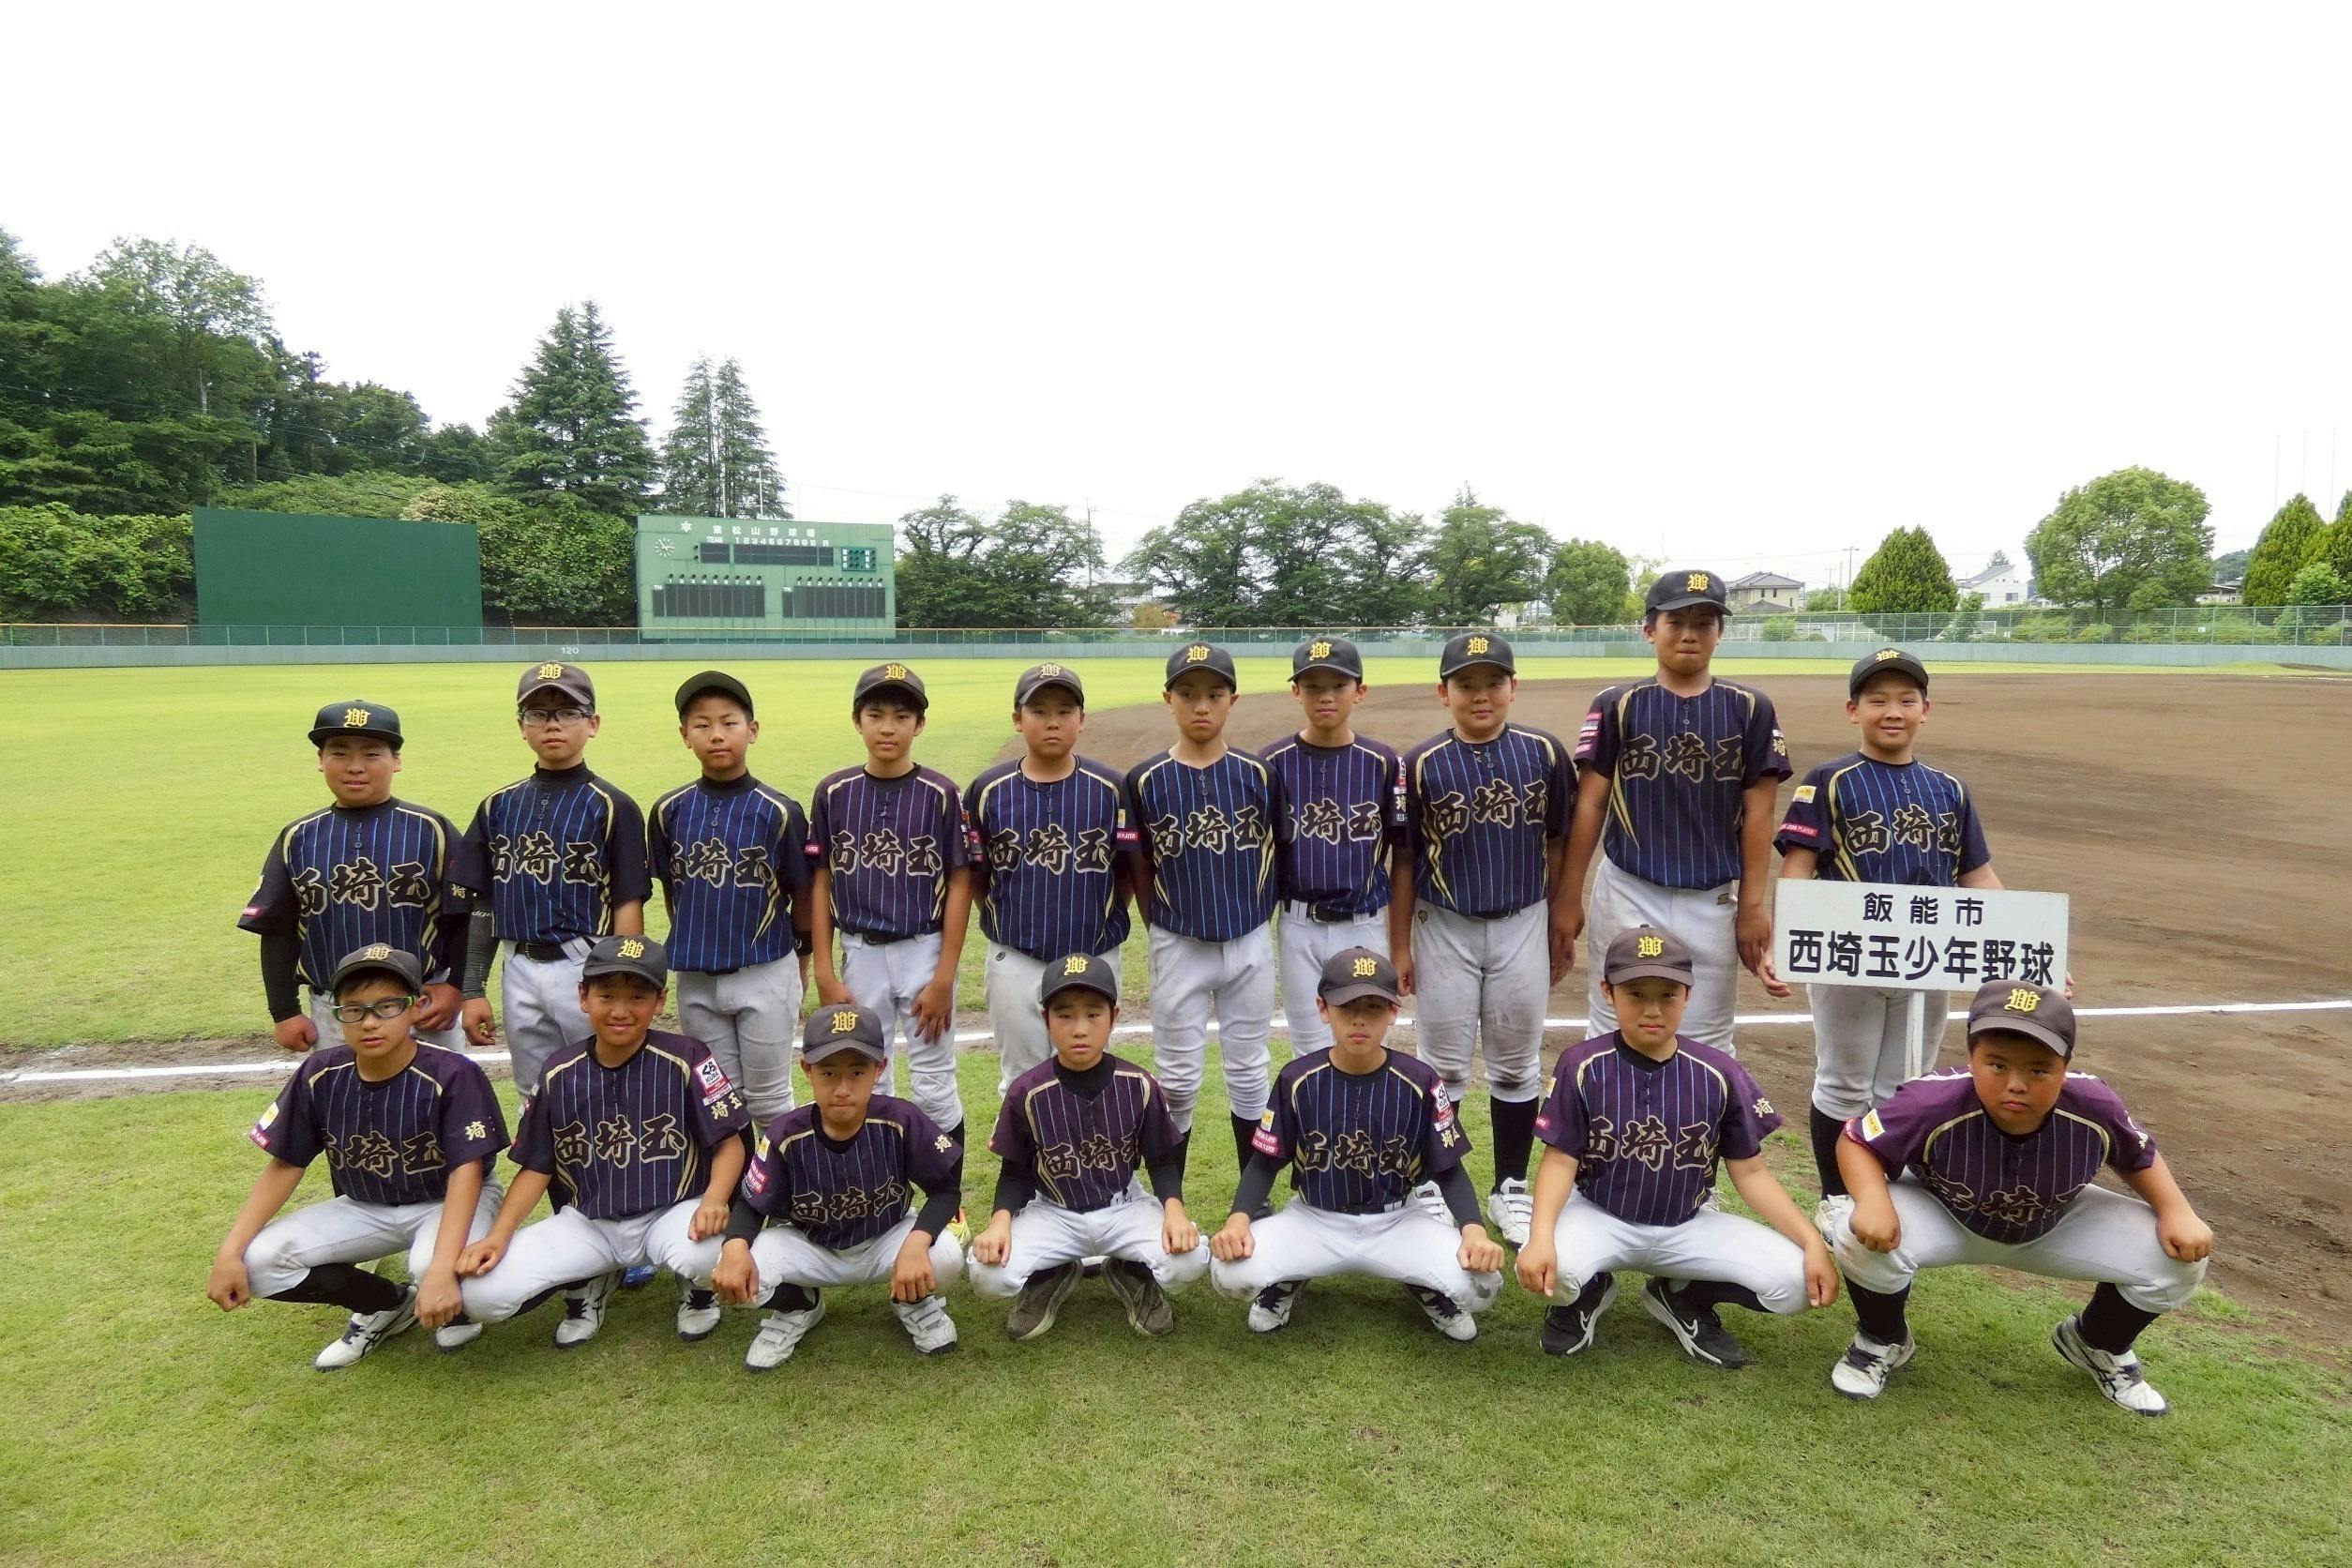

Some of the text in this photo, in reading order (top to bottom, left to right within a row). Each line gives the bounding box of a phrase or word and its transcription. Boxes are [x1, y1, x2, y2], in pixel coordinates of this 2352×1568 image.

[1620, 731, 1746, 784] 西埼玉
[1150, 805, 1266, 857] 西埼玉
[1289, 797, 1382, 846] 埼玉
[1431, 778, 1545, 839] 西埼玉
[1845, 803, 1960, 857] 西埼玉
[489, 830, 603, 885] 西埼玉
[831, 828, 942, 877] 西埼玉
[987, 823, 1111, 876] 西埼玉
[292, 856, 431, 918] 西埼玉
[1862, 892, 1984, 927] 飯能市
[1788, 928, 2055, 986] 西埼玉少年野球
[465, 1121, 486, 1141] 埼
[711, 1092, 743, 1120] 埼玉
[553, 1113, 687, 1169] 西埼玉
[1303, 1130, 1411, 1179] 西埼玉
[1589, 1115, 1712, 1172] 西埼玉
[790, 1176, 906, 1223] 西埼玉
